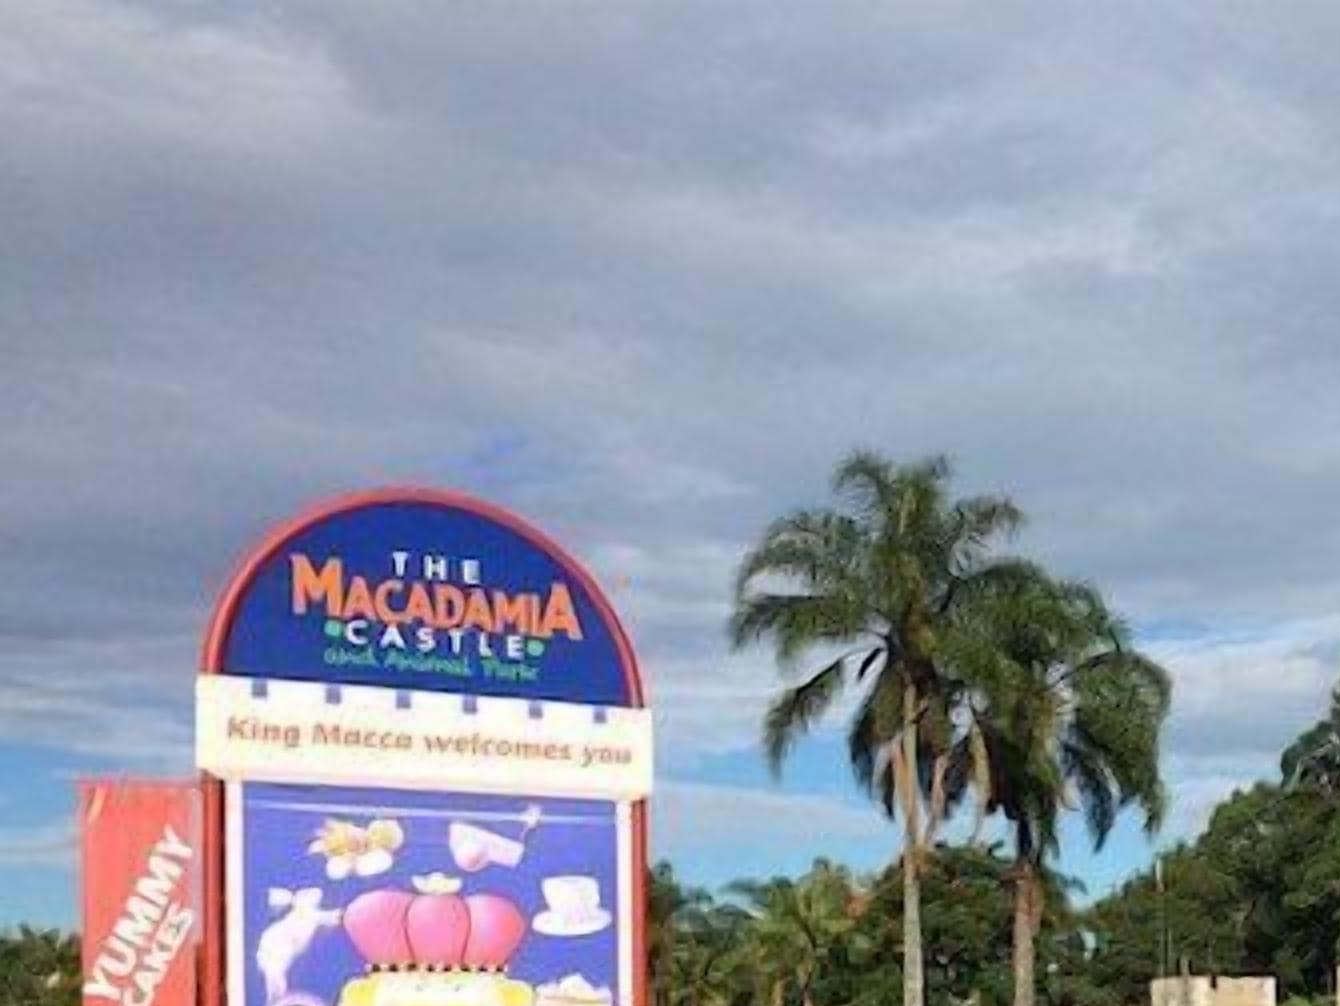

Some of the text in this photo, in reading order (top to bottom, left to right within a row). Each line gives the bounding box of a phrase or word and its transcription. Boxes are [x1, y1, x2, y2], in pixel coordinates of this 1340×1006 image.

[392, 550, 481, 584] THE
[290, 553, 584, 641] MACADAMIA
[344, 618, 525, 660] CASTLE
[226, 716, 301, 747] King
[423, 733, 573, 761] welcomes
[581, 743, 632, 768] you
[82, 824, 193, 1001] YUMMY
